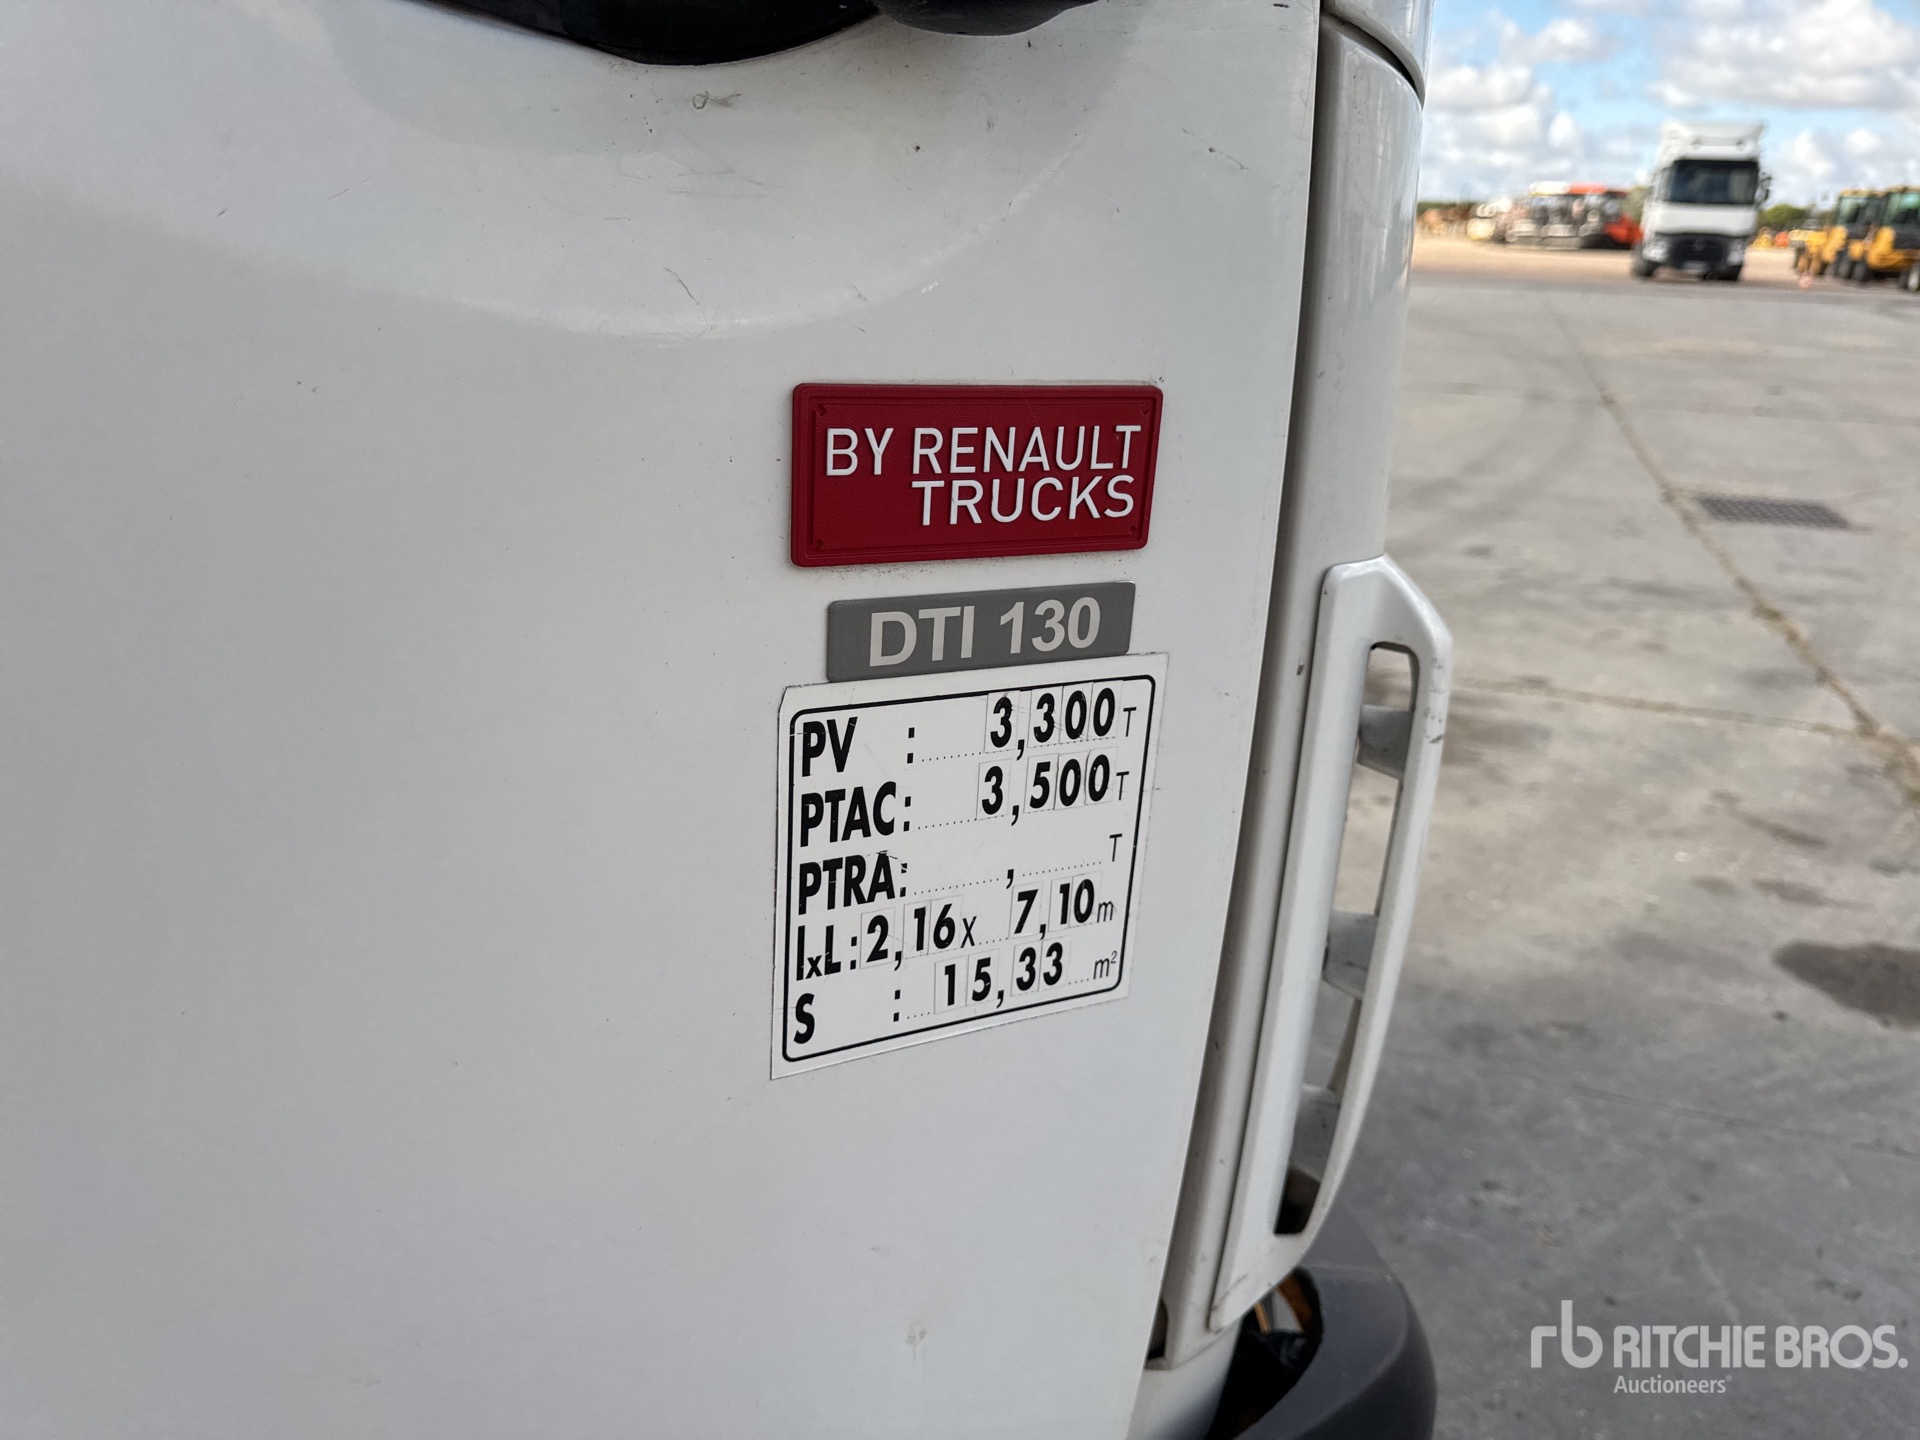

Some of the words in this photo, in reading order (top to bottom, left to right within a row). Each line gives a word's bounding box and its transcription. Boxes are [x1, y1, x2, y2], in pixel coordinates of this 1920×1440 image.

[826, 427, 893, 476] BY
[912, 425, 1141, 474] RENAULT
[912, 475, 1134, 526] TRUCKS
[869, 605, 975, 667] DTI
[999, 596, 1101, 653] 130
[801, 716, 858, 776] PV
[799, 781, 912, 847] PTAC:
[798, 850, 908, 915] PTRA:
[793, 993, 816, 1044] S
[944, 941, 1064, 1008] 15,33
